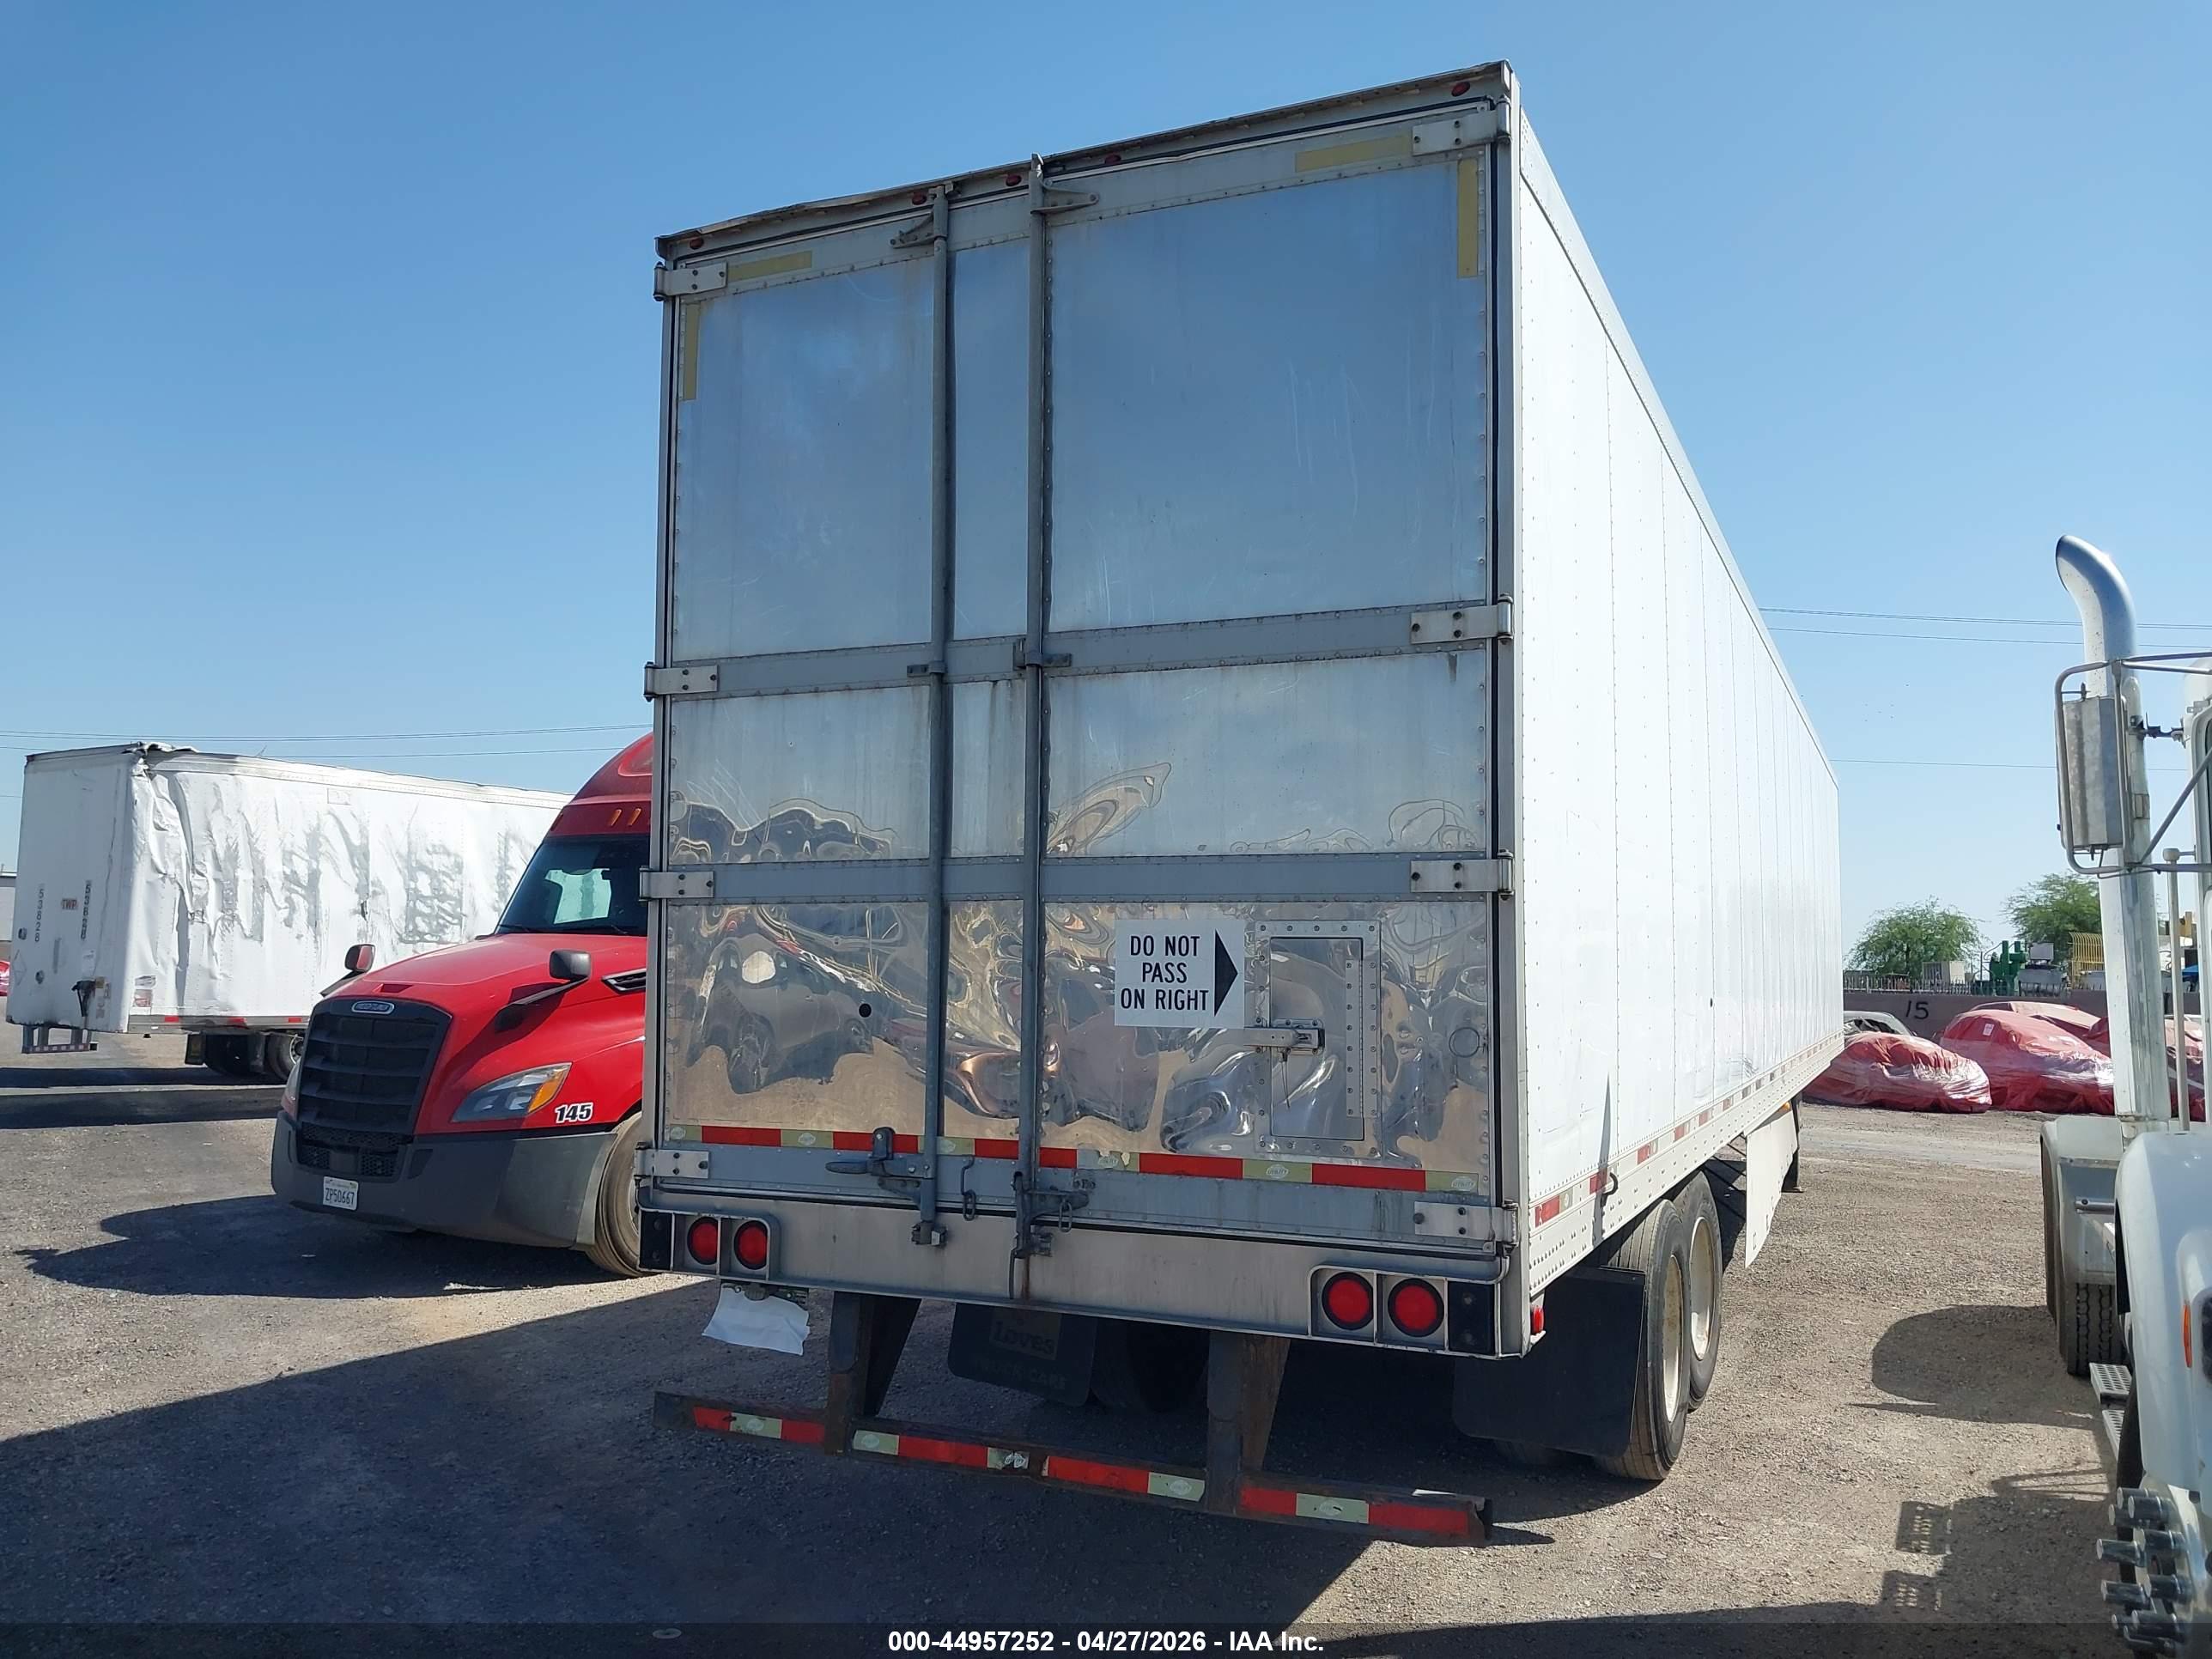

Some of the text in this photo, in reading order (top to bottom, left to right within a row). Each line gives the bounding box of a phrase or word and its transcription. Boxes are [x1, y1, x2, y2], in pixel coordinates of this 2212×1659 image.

[34, 888, 45, 942] 53828
[1130, 935, 1200, 957] DO NOT
[1142, 962, 1187, 983] PASS
[1121, 988, 1209, 1011] ON RIGHT
[1905, 1000, 1929, 1019] 15
[555, 1102, 593, 1123] 145
[325, 1188, 355, 1205] ZP50667
